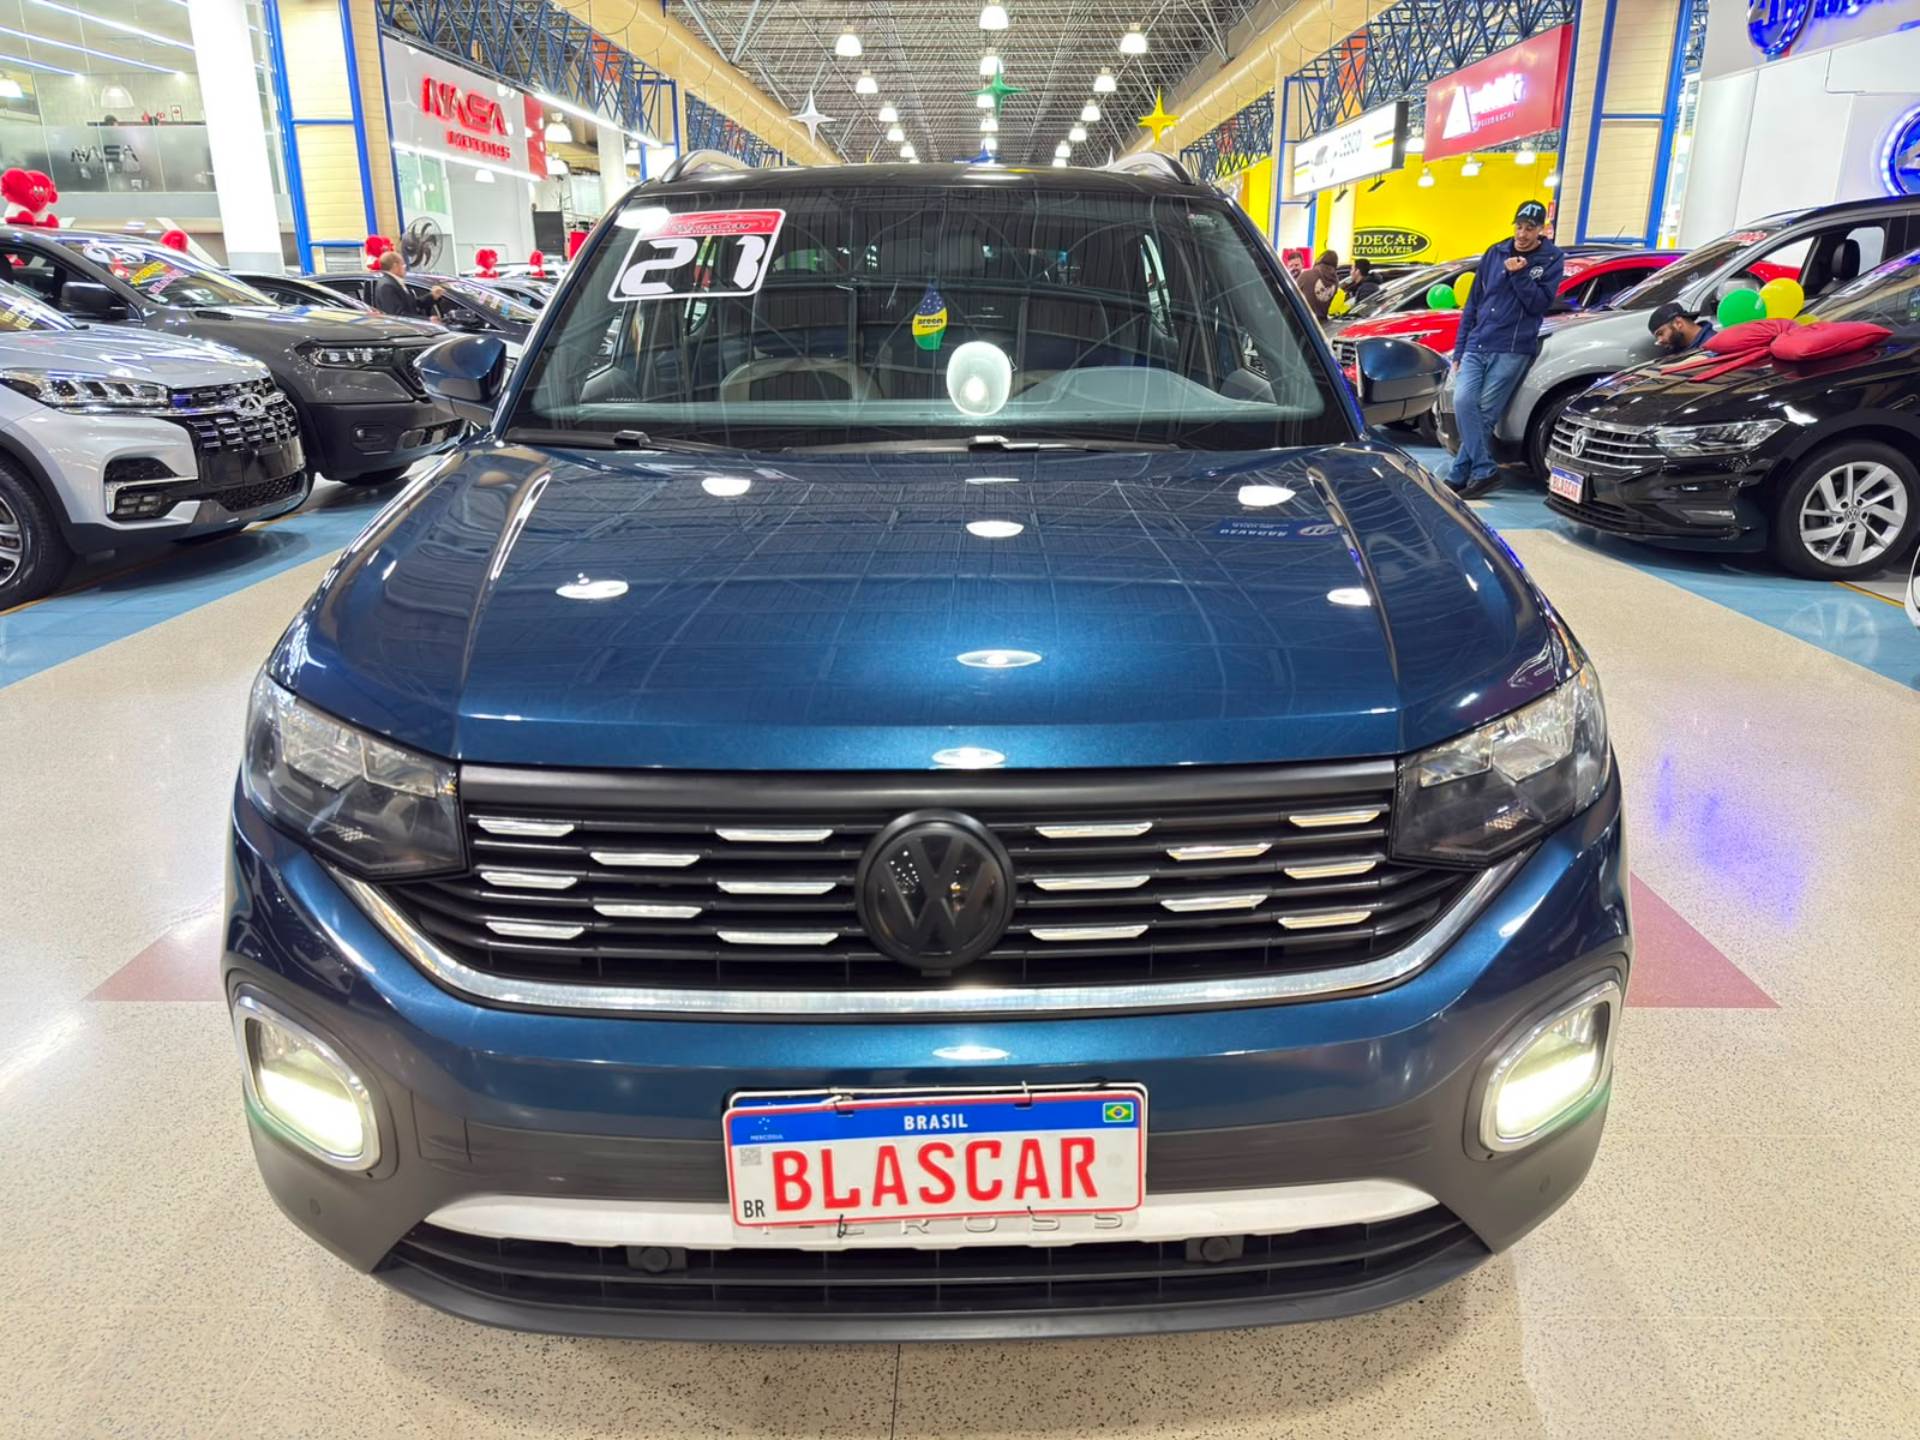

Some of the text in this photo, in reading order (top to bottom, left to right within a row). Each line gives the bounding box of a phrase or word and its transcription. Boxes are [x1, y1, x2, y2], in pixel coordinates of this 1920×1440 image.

[422, 76, 509, 136] NASA
[1518, 203, 1542, 217] AT
[903, 1114, 968, 1131] BRASIL
[772, 1136, 1098, 1212] BLASCAR
[743, 1199, 766, 1218] BR
